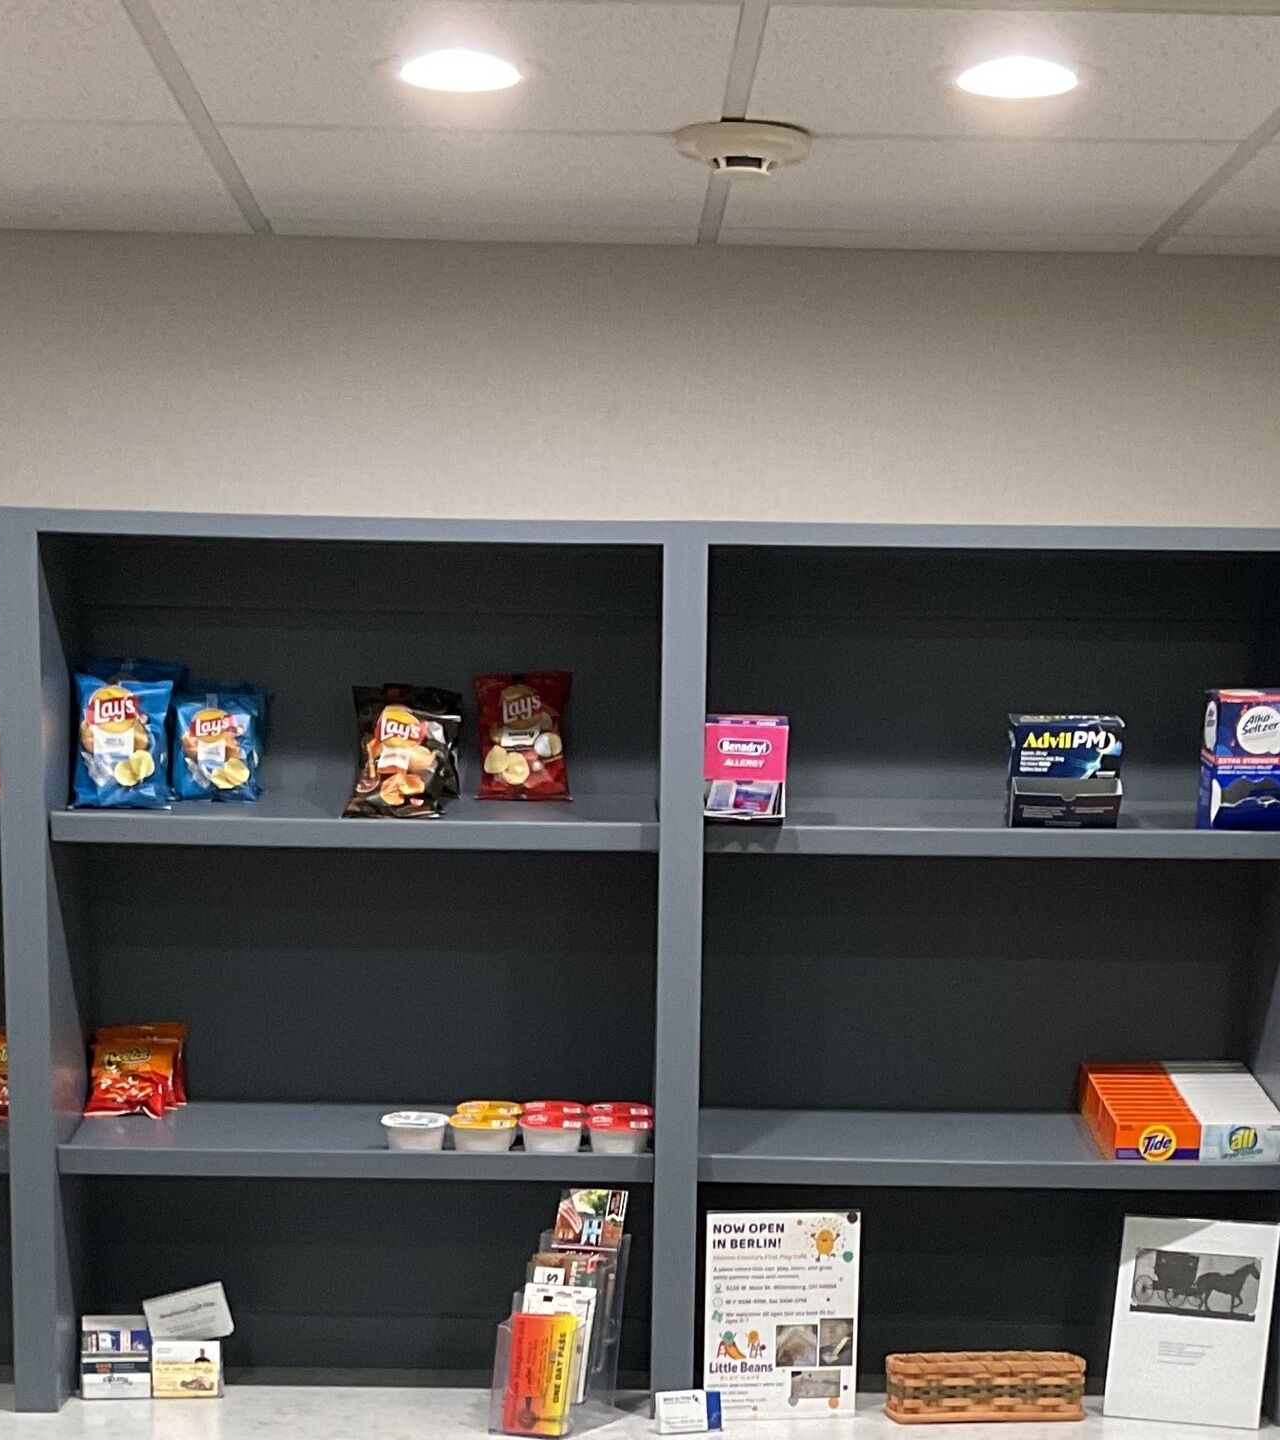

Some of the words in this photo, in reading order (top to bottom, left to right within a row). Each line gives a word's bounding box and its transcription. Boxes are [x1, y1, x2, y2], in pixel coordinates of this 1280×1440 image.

[94, 695, 136, 725] Lay's
[502, 694, 541, 723] Lay's
[195, 716, 231, 738] Lay's
[380, 717, 421, 741] Lay's
[1241, 721, 1280, 736] Seltzer
[722, 740, 767, 755] Benadryl
[1022, 731, 1072, 749] Advil
[1072, 730, 1107, 749] PM
[724, 759, 766, 768] ALLERGY
[1142, 1135, 1173, 1155] Tide
[1231, 1127, 1257, 1151] all
[713, 1223, 745, 1234] NOW
[748, 1222, 785, 1234] OPEN
[712, 1239, 726, 1249] IN
[730, 1238, 782, 1249] BERLIN!
[558, 1333, 567, 1358] PASS
[555, 1359, 565, 1381] DAY
[709, 1361, 738, 1374] Little
[740, 1361, 774, 1374] Beans
[552, 1383, 562, 1404] ONE
